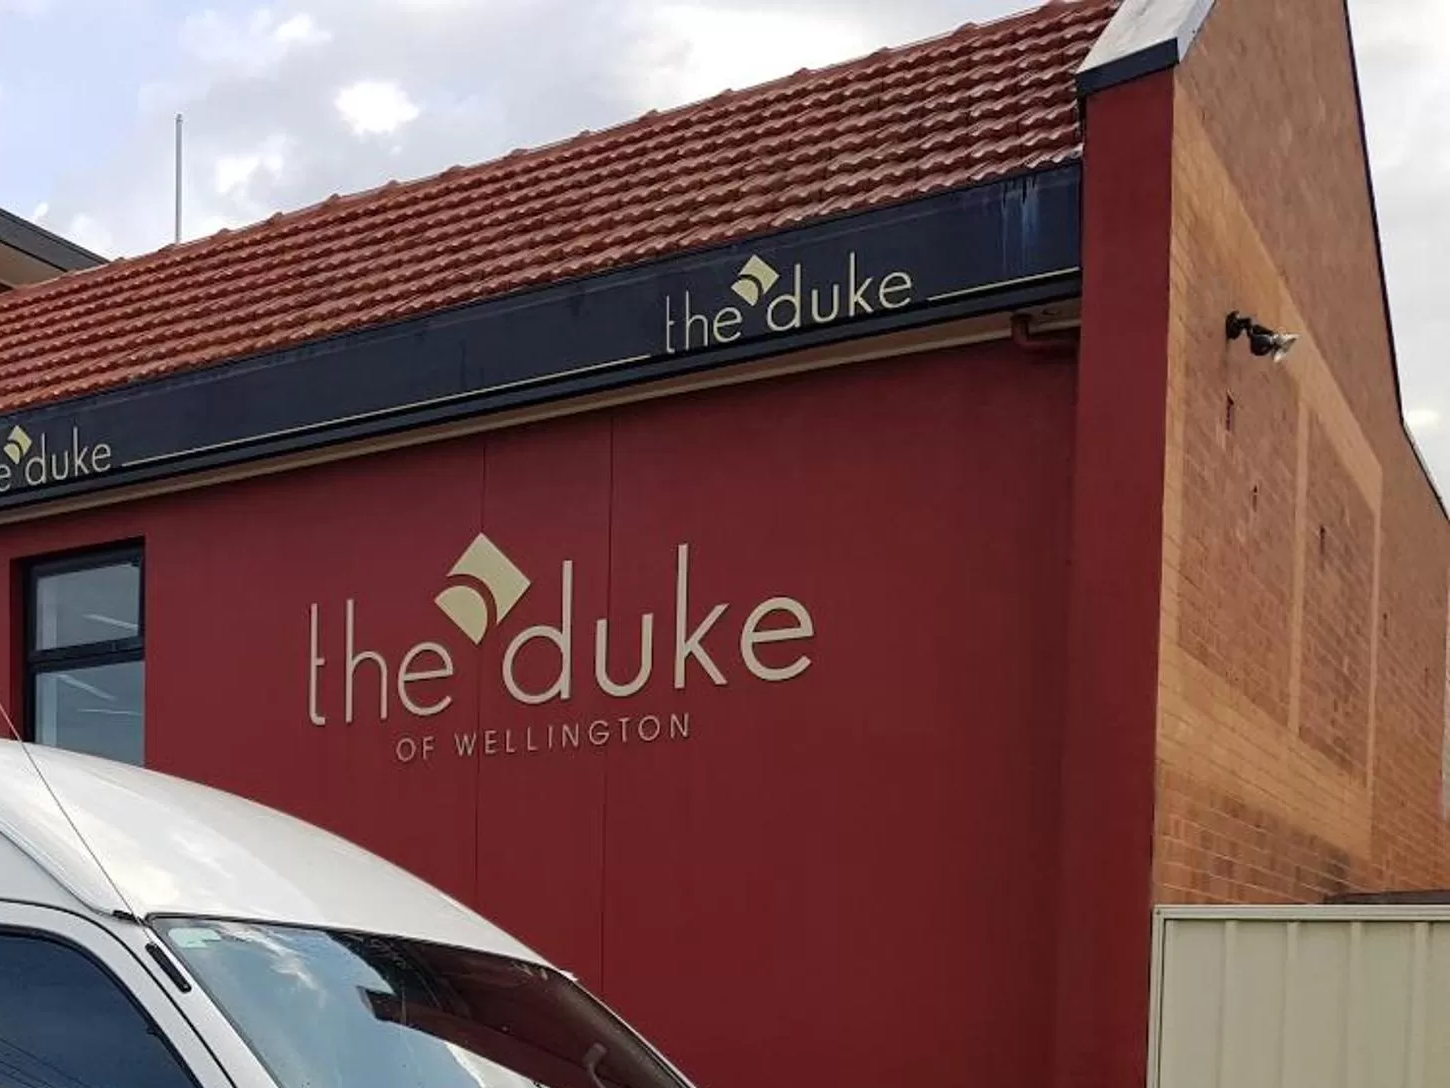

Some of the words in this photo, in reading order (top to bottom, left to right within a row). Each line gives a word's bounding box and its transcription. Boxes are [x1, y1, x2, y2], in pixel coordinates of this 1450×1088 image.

[665, 289, 743, 354] the
[765, 251, 913, 332] duke
[24, 425, 112, 486] duke
[308, 598, 455, 726] the
[501, 542, 816, 705] duke
[395, 735, 436, 763] OF
[453, 712, 692, 758] WELLINGTON
